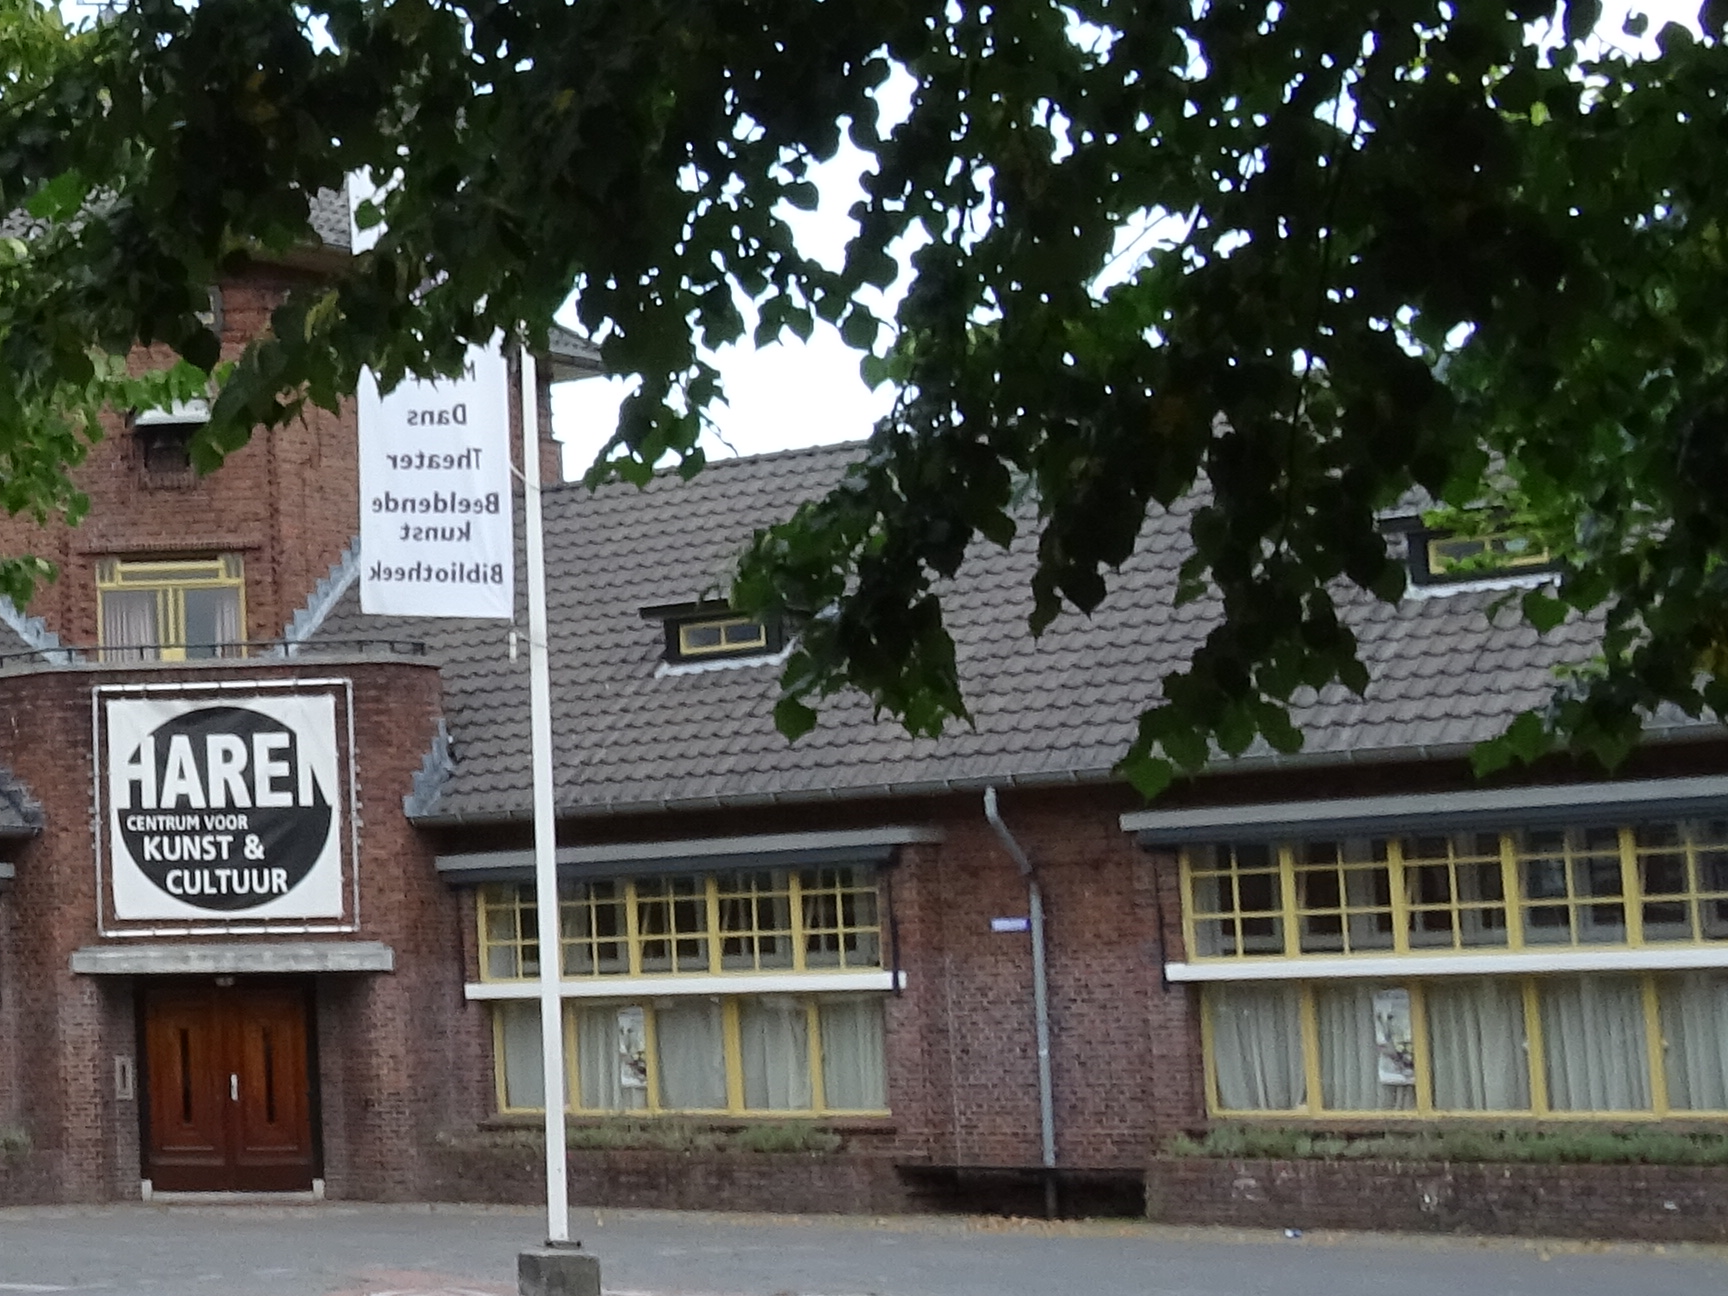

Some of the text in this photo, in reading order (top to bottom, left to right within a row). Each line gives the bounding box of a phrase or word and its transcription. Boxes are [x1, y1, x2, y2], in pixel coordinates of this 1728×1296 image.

[113, 732, 337, 810] HAREN
[126, 814, 248, 832] CENTRUM VOOR
[144, 834, 265, 861] KUNST &
[166, 868, 289, 895] CULTUUR
